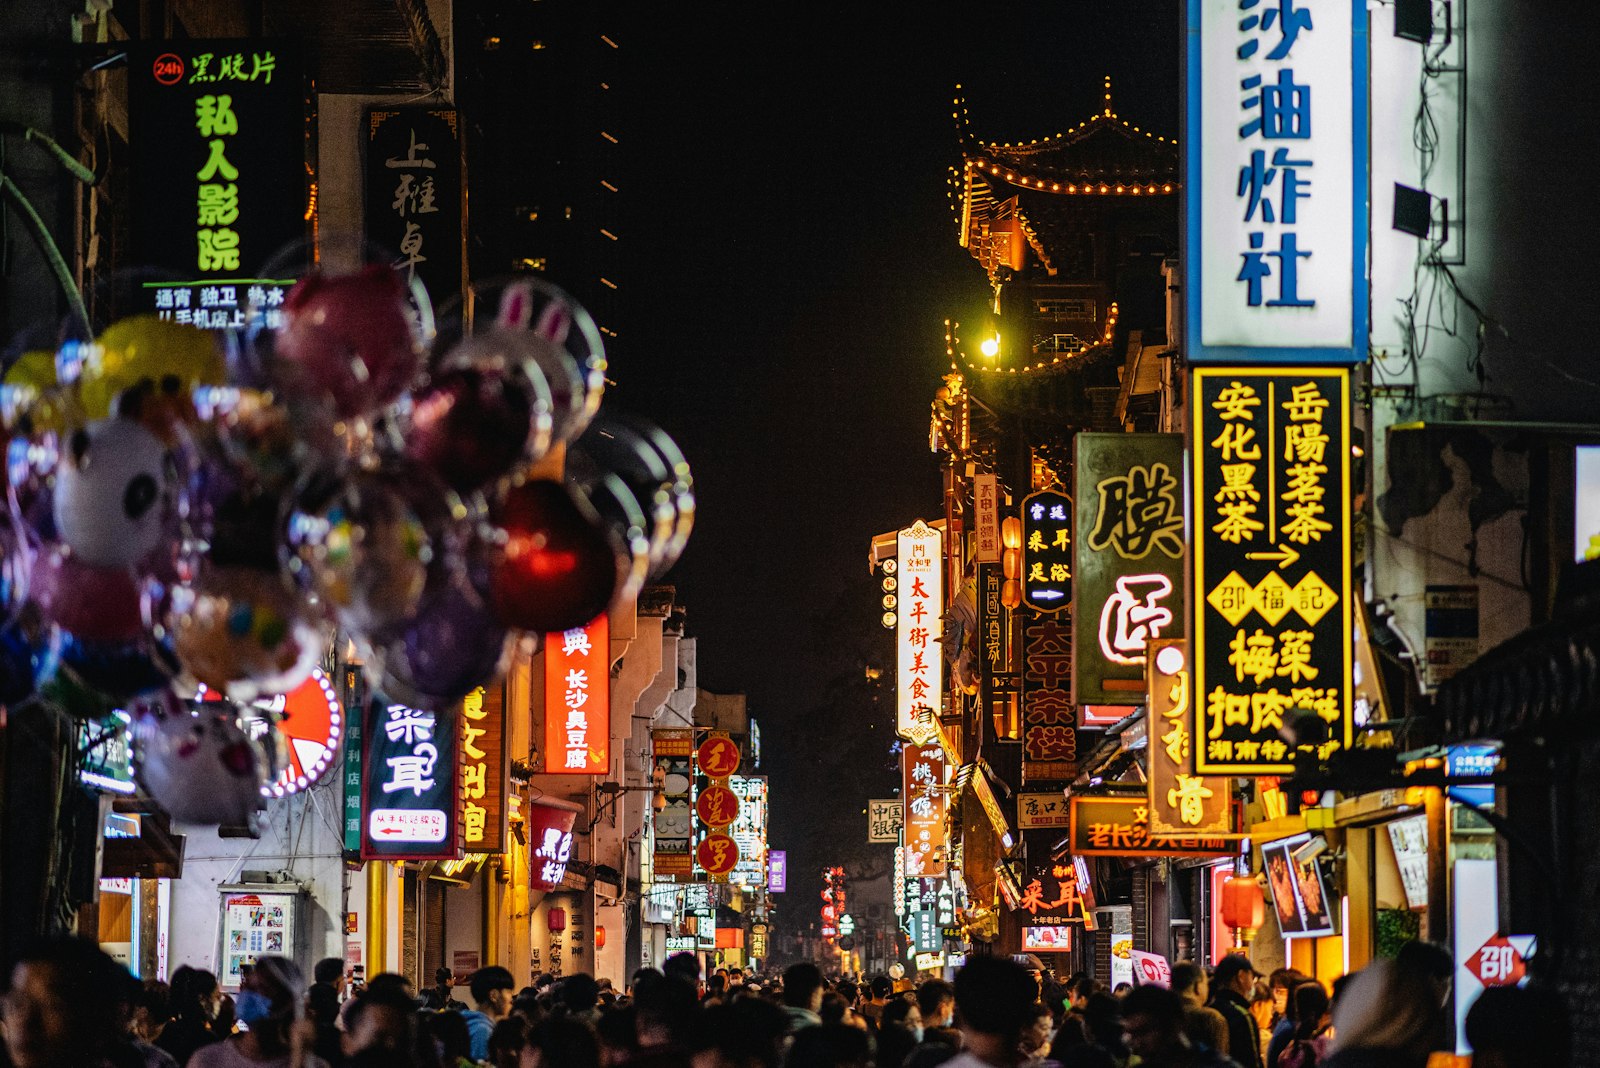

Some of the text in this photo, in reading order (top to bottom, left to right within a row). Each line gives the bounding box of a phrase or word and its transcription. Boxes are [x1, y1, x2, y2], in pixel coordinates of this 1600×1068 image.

[156, 62, 181, 75] 24h
[188, 51, 275, 85] 黑胶片
[1237, 0, 1316, 307] 沙油炸社
[195, 94, 240, 271] 私人影院
[156, 286, 284, 308] 通宵 独卫 热水
[1211, 381, 1265, 544] 安化黑茶
[1280, 381, 1333, 545] 岳陽茗茶
[907, 558, 931, 567] 文和里
[1028, 529, 1071, 552] 采耳
[1027, 562, 1072, 582] 足浴
[908, 576, 930, 725] 太平街美食城
[1228, 628, 1319, 685] 梅菜
[1026, 620, 1077, 761] 太平茶楼
[565, 669, 588, 769] 长沙臭豆腐
[382, 704, 438, 796] 采耳
[347, 725, 361, 832] 便利店烟酒
[873, 805, 903, 820] 中国
[536, 827, 573, 863] 黑色
[1022, 878, 1080, 917] 采耳
[1032, 916, 1062, 925] 十年老店
